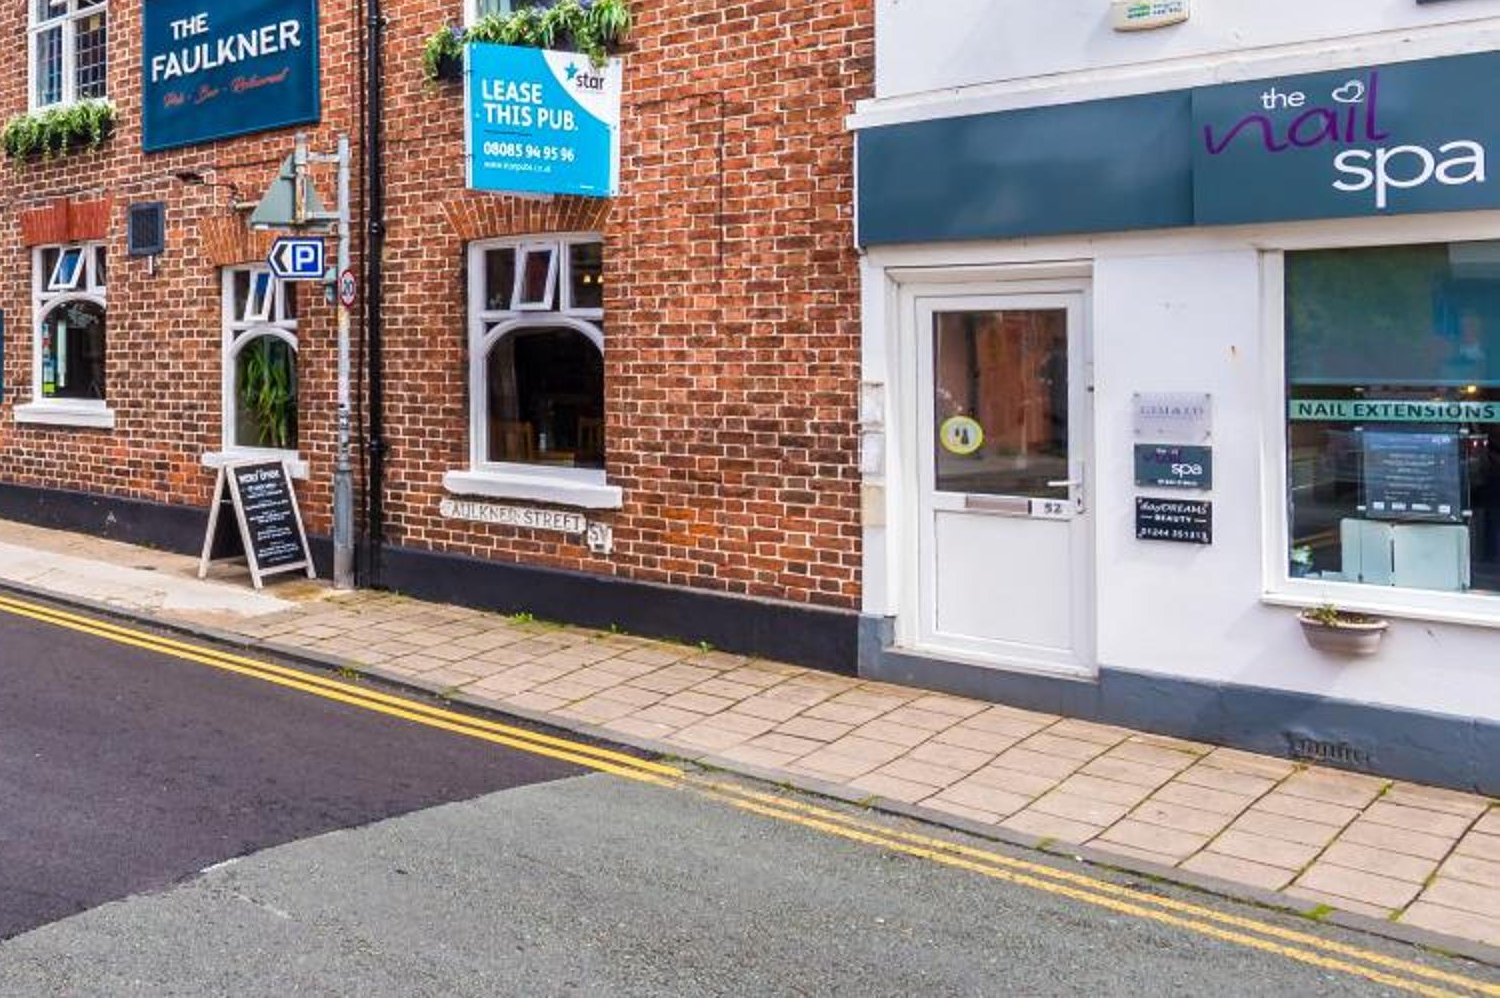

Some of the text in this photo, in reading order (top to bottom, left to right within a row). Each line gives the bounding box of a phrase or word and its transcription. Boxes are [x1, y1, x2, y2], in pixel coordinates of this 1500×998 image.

[170, 12, 209, 40] THE
[152, 19, 301, 83] FAULKNER
[482, 79, 543, 104] LEASE
[576, 73, 605, 90] star
[1261, 87, 1306, 109] the
[484, 103, 579, 131] THIS PUB.
[1204, 70, 1391, 154] nail
[484, 141, 575, 163] 08085 94 95 96
[1332, 140, 1486, 209] spa
[296, 245, 315, 270] P
[1299, 403, 1495, 419] NAIL EXTENSIONS
[1172, 463, 1202, 478] spa
[523, 511, 581, 531] STREET
